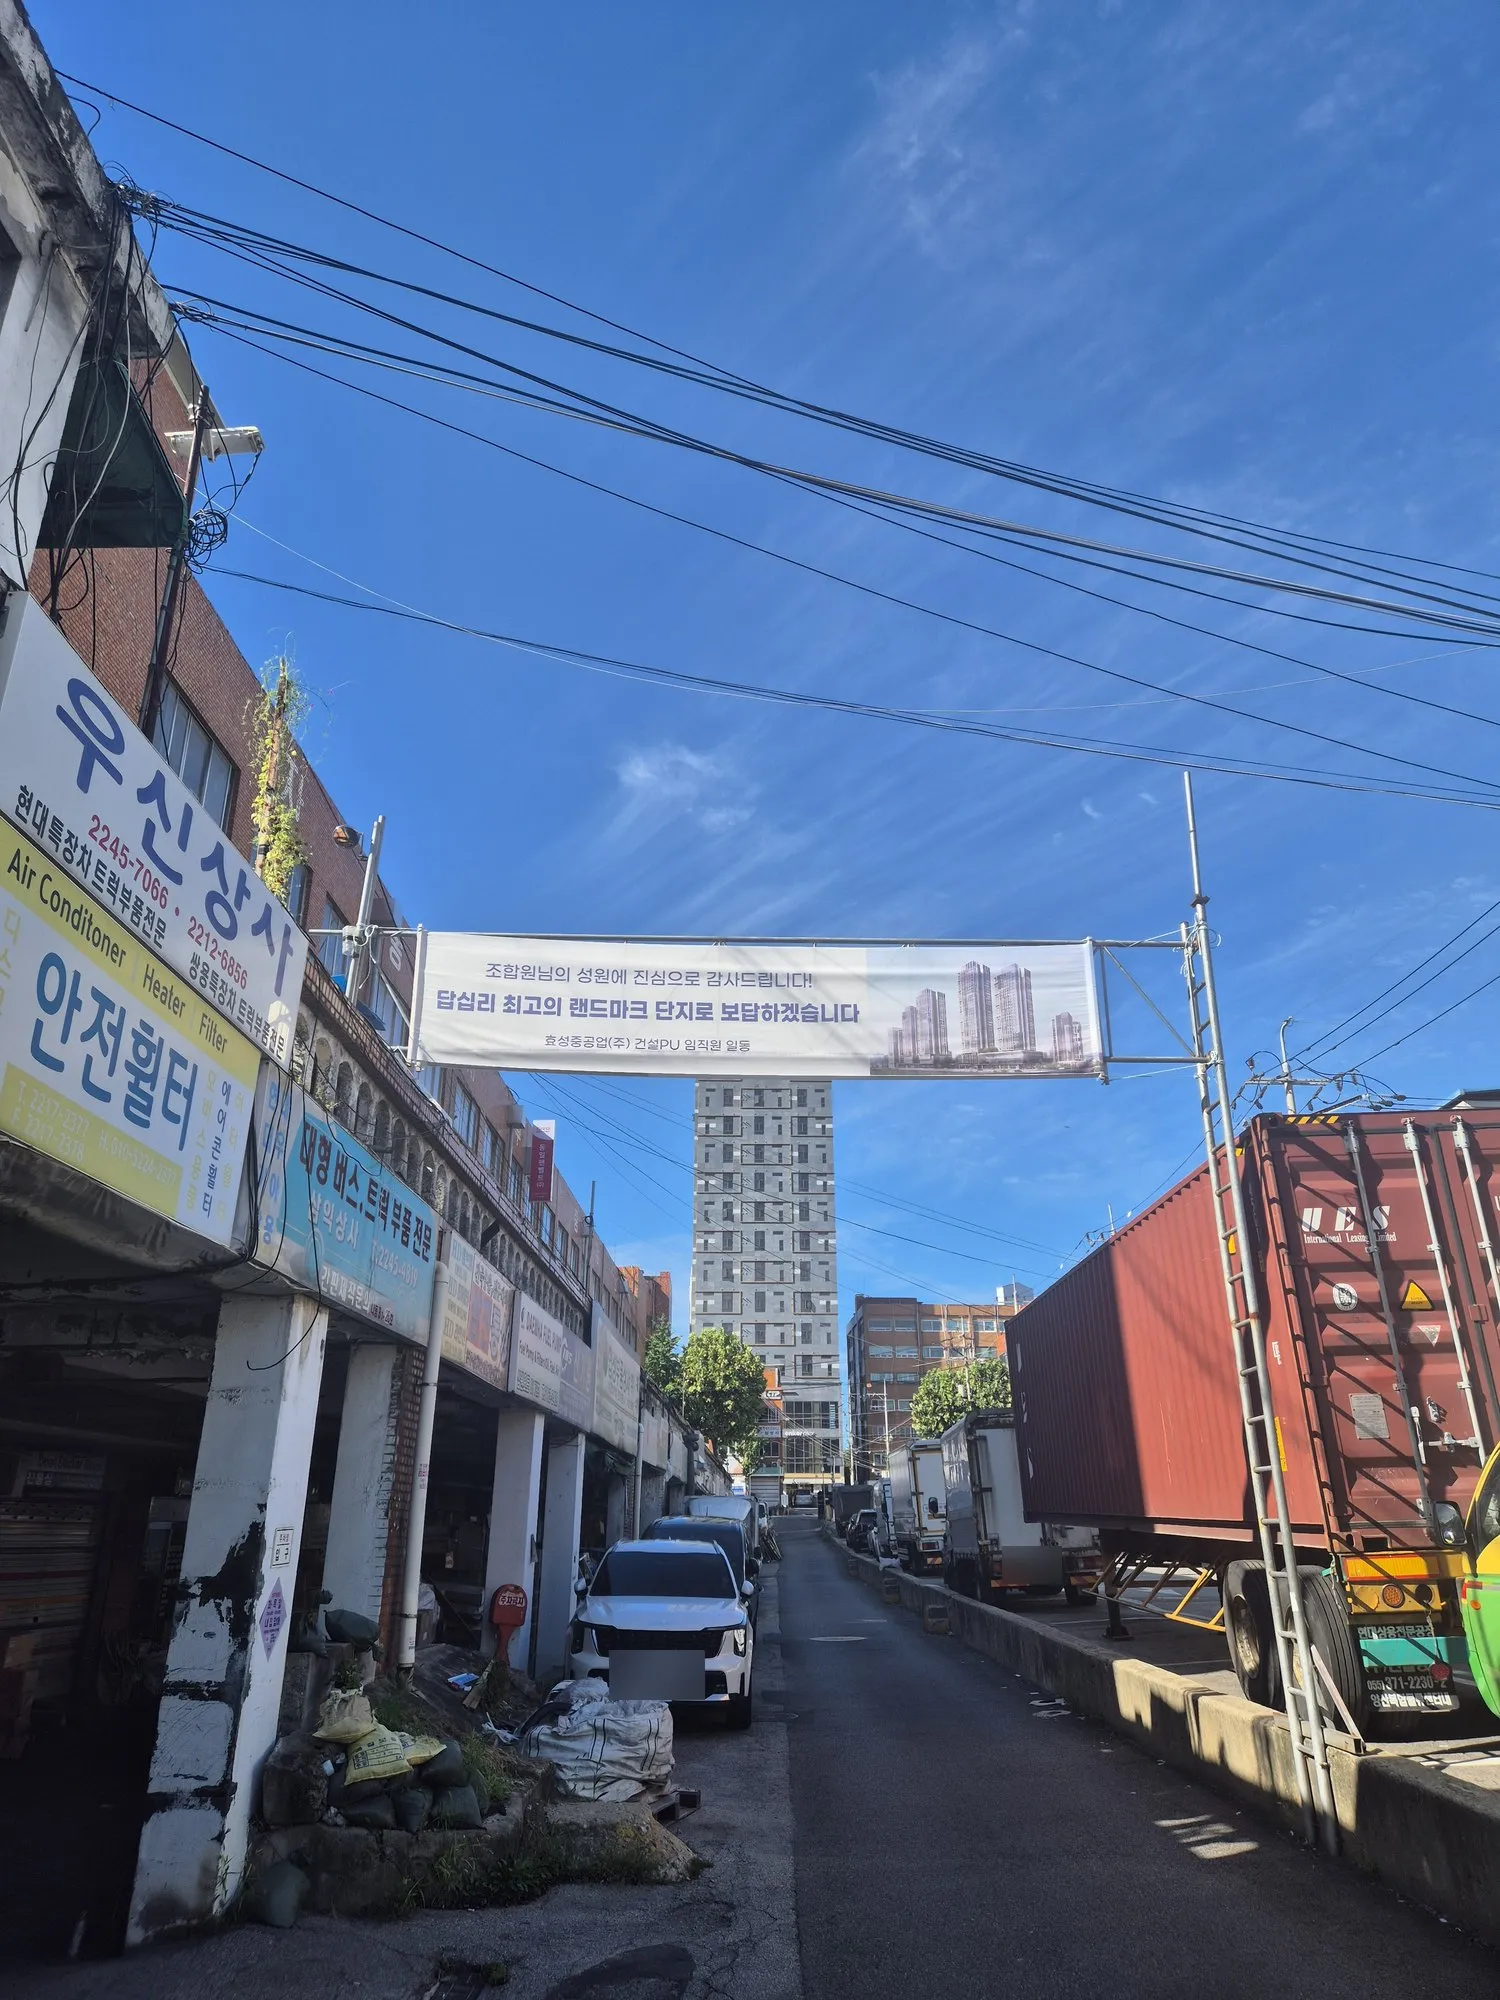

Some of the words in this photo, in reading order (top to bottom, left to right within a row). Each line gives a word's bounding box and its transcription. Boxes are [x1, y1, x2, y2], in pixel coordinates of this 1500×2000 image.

[15, 785, 92, 879] 현대특장차
[91, 858, 167, 949] 트럭부품전문
[56, 677, 294, 998] 우신상사
[88, 814, 169, 910] 2245-7066
[187, 915, 248, 990] 2212-6856
[7, 848, 37, 890] Air
[39, 873, 127, 968] Conditoner
[142, 963, 186, 1018] Heater
[198, 1012, 228, 1054] Filter
[485, 962, 570, 983] 조합원님의
[577, 966, 627, 985] 성원에
[634, 968, 701, 987] 진심으로
[706, 970, 812, 989] 감사드립니다!
[236, 998, 285, 1061] 트럭부품전문
[436, 989, 496, 1013] 답십리
[502, 994, 562, 1017] 최고의
[569, 997, 649, 1020] 랜드마크
[655, 999, 714, 1022] 단지로
[720, 1001, 860, 1024] 보답하겠습니다
[30, 951, 198, 1151] 안전휠터
[544, 1034, 631, 1051] 효성중공업(주)
[633, 1037, 680, 1051] 건설PU
[684, 1038, 722, 1052] 임직원
[726, 1039, 751, 1052] 일동
[299, 1121, 332, 1186] 대형
[1303, 1232, 1342, 1244] International
[1346, 1232, 1370, 1245] Leasing
[500, 1595, 524, 1606] 주차금지
